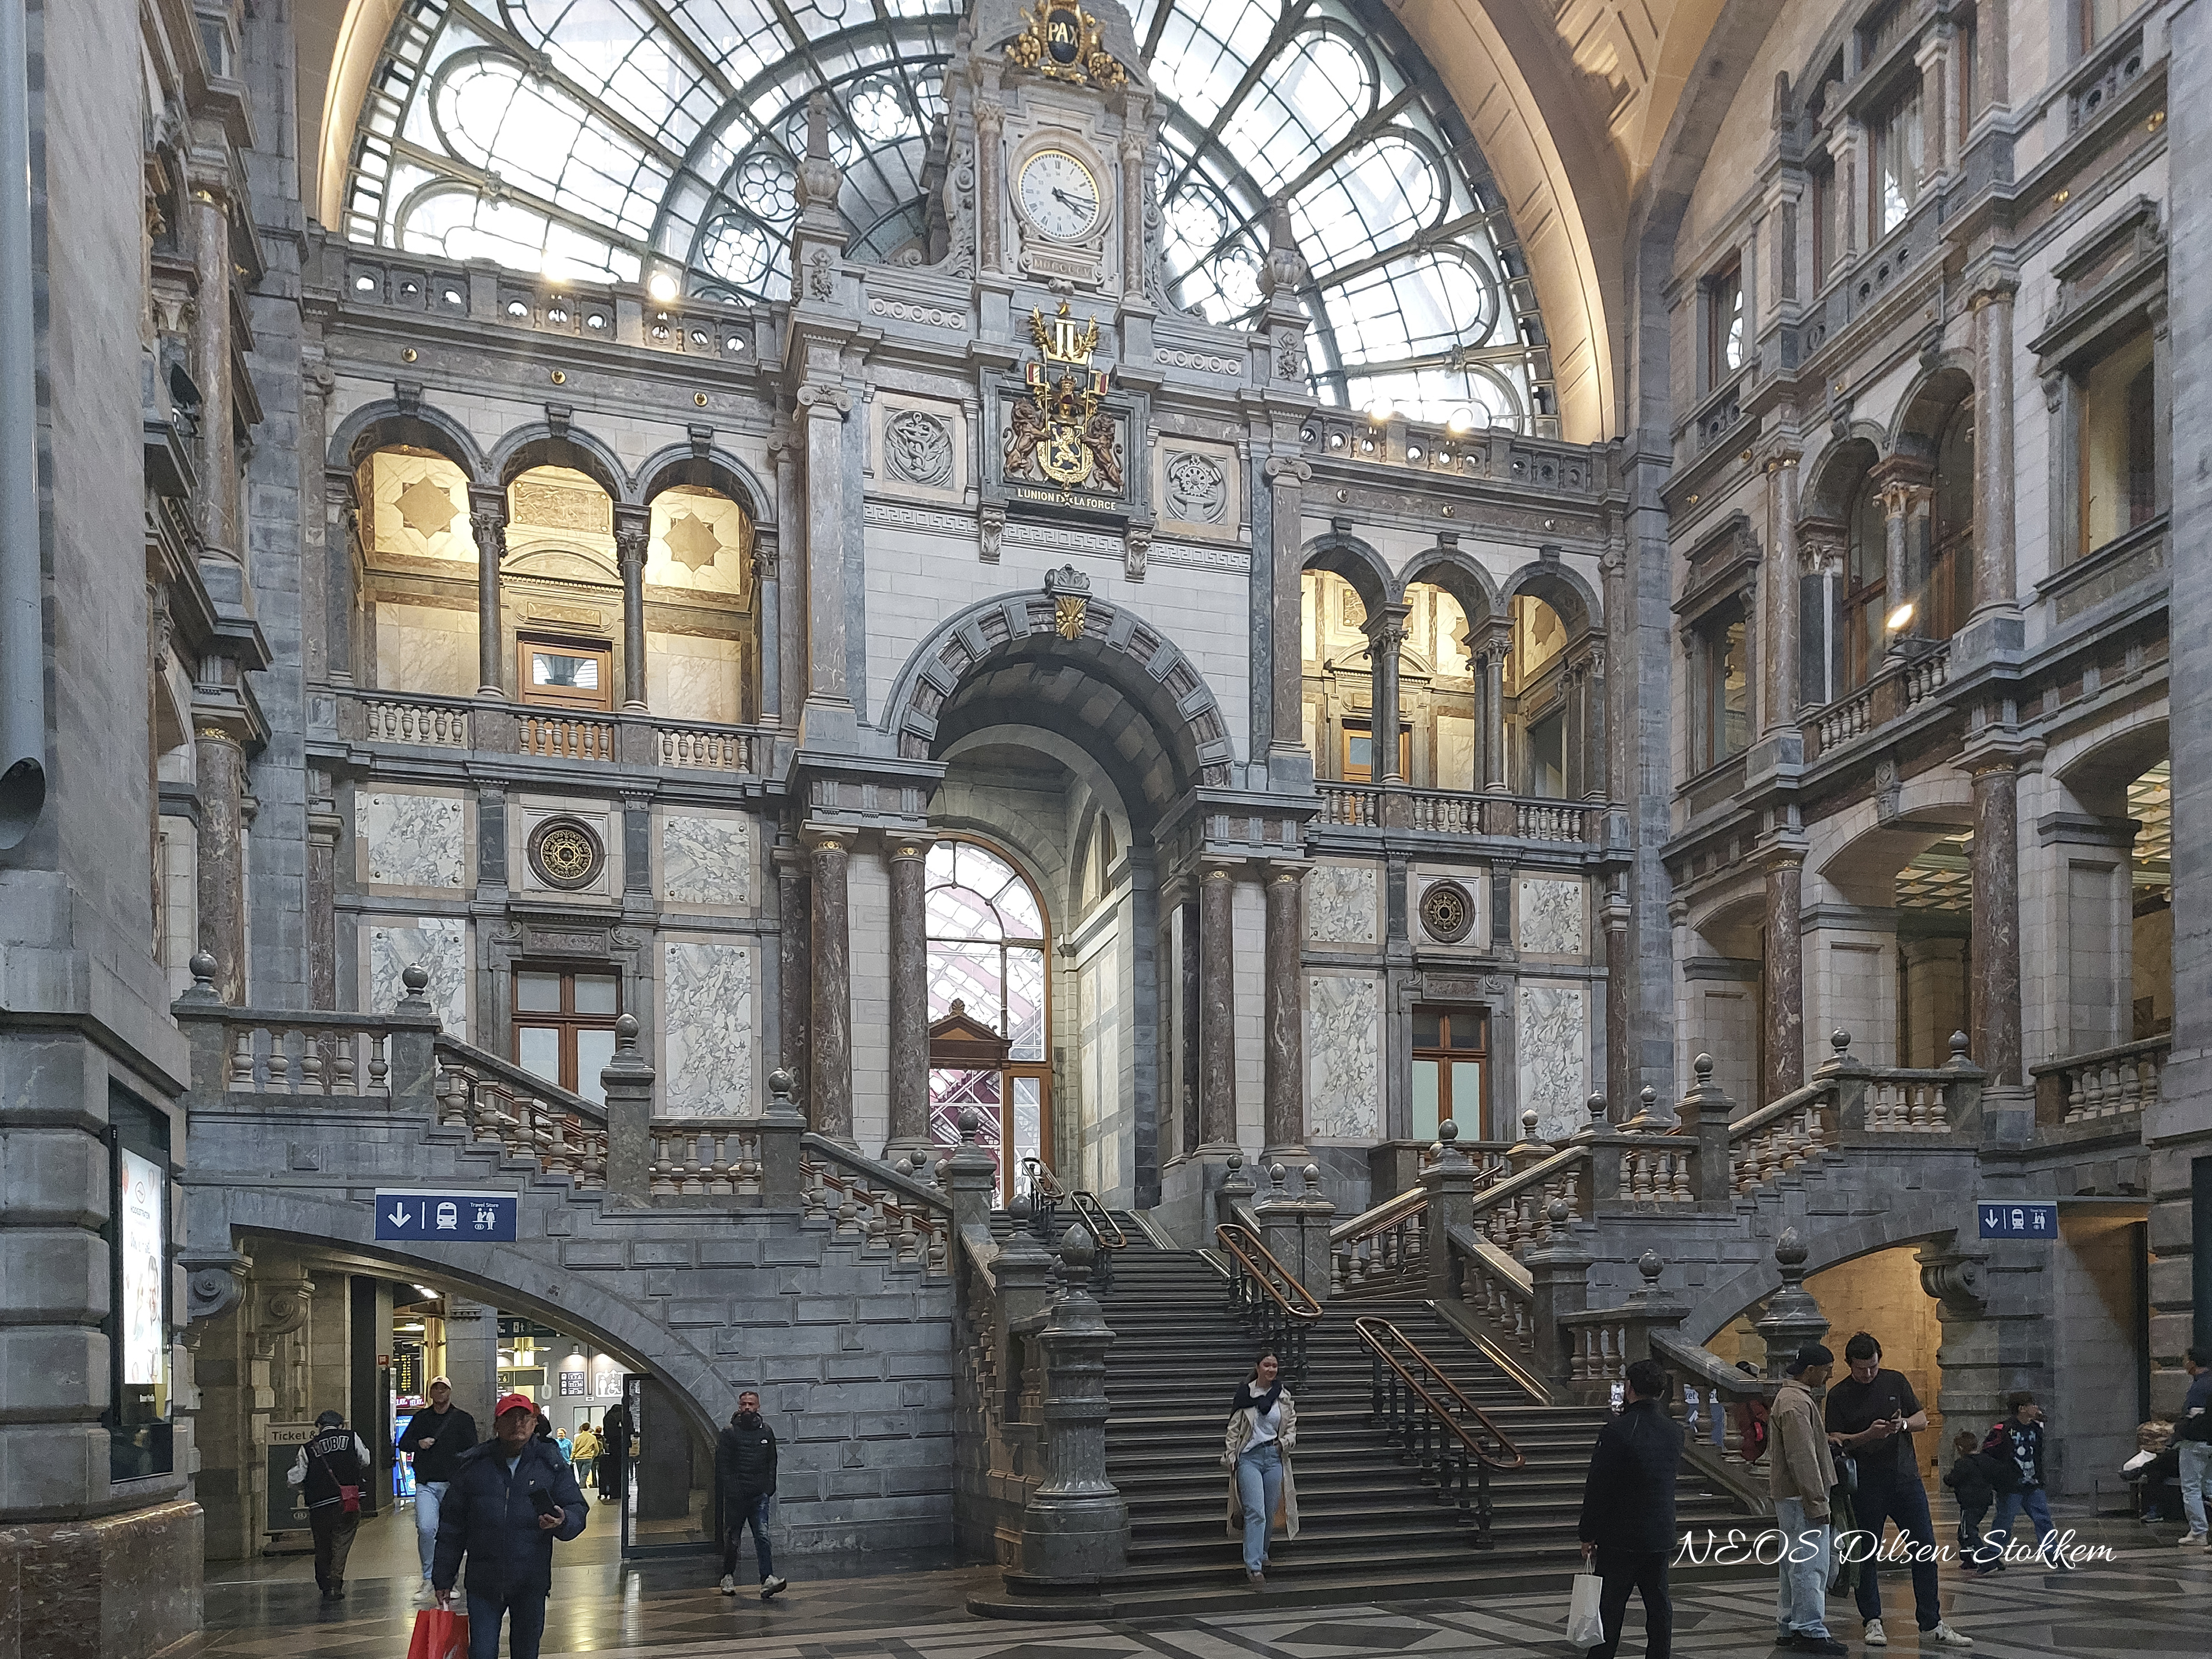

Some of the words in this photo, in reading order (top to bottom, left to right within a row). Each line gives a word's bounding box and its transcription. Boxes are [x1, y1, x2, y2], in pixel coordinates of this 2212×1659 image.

[1047, 21, 1079, 48] PAX
[1074, 496, 1085, 507] LA
[1086, 498, 1116, 511] FORCE
[271, 1431, 306, 1441] Ticket
[309, 1430, 316, 1439] &
